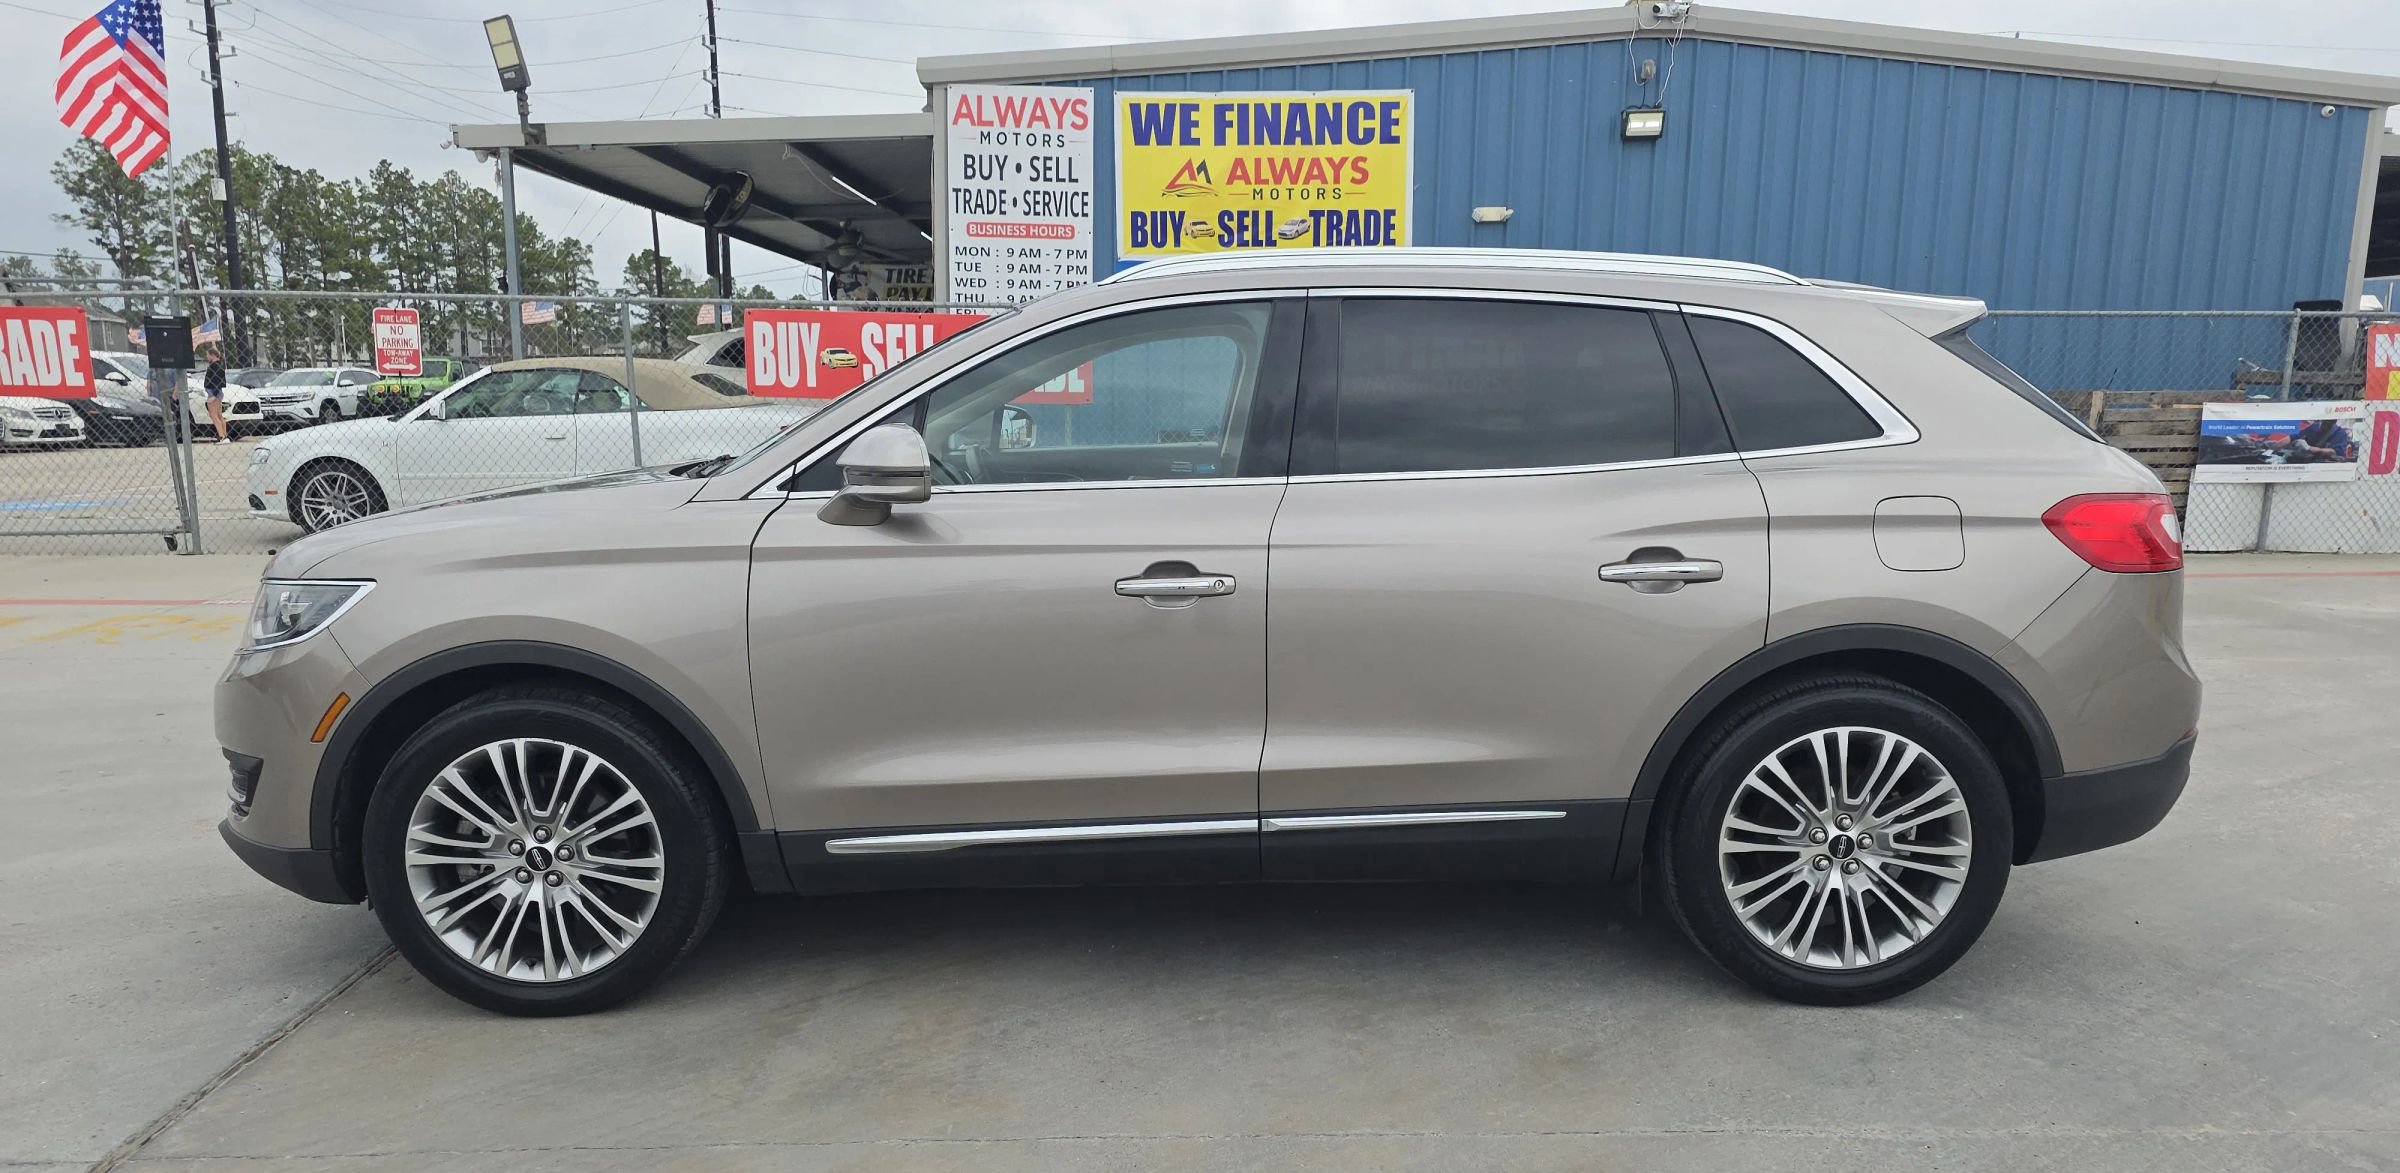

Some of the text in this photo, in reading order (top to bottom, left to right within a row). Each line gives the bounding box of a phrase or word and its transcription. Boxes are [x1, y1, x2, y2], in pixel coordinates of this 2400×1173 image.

[952, 94, 1089, 131] ALWAYS
[1129, 101, 1400, 146] WE FINANCE
[980, 131, 1065, 148] MOTORS
[963, 154, 1008, 181] BUY
[1029, 155, 1079, 183] SELL
[1225, 156, 1370, 186] ALWAYS
[1252, 187, 1343, 201] MOTORS
[952, 187, 1007, 216] TRADE
[1022, 189, 1089, 218] SERVICE
[968, 223, 1073, 238] BUSINESS HOURS
[1131, 208, 1397, 249] BUY SELL TRADE
[955, 246, 991, 257] MON
[1007, 248, 1015, 258] 9
[1018, 248, 1041, 259] AM
[1053, 249, 1062, 260] 7
[1066, 249, 1088, 260] PM
[955, 262, 982, 272] TUE
[1007, 264, 1015, 274] 9
[1018, 264, 1041, 274] AM
[1053, 265, 1062, 275] 7
[1066, 265, 1088, 275] PM
[884, 268, 928, 284] TIRE
[955, 277, 987, 288] WED
[1007, 278, 1015, 289] 9
[1018, 279, 1041, 290] AM
[1053, 280, 1062, 290] 7
[955, 293, 985, 303] THU
[380, 315, 412, 324] FIRE LANE
[390, 325, 404, 336] NO
[381, 337, 414, 349] PARKING
[384, 349, 414, 358] TOW-AWAY
[391, 356, 408, 364] ZONE
[753, 320, 821, 388] BUY
